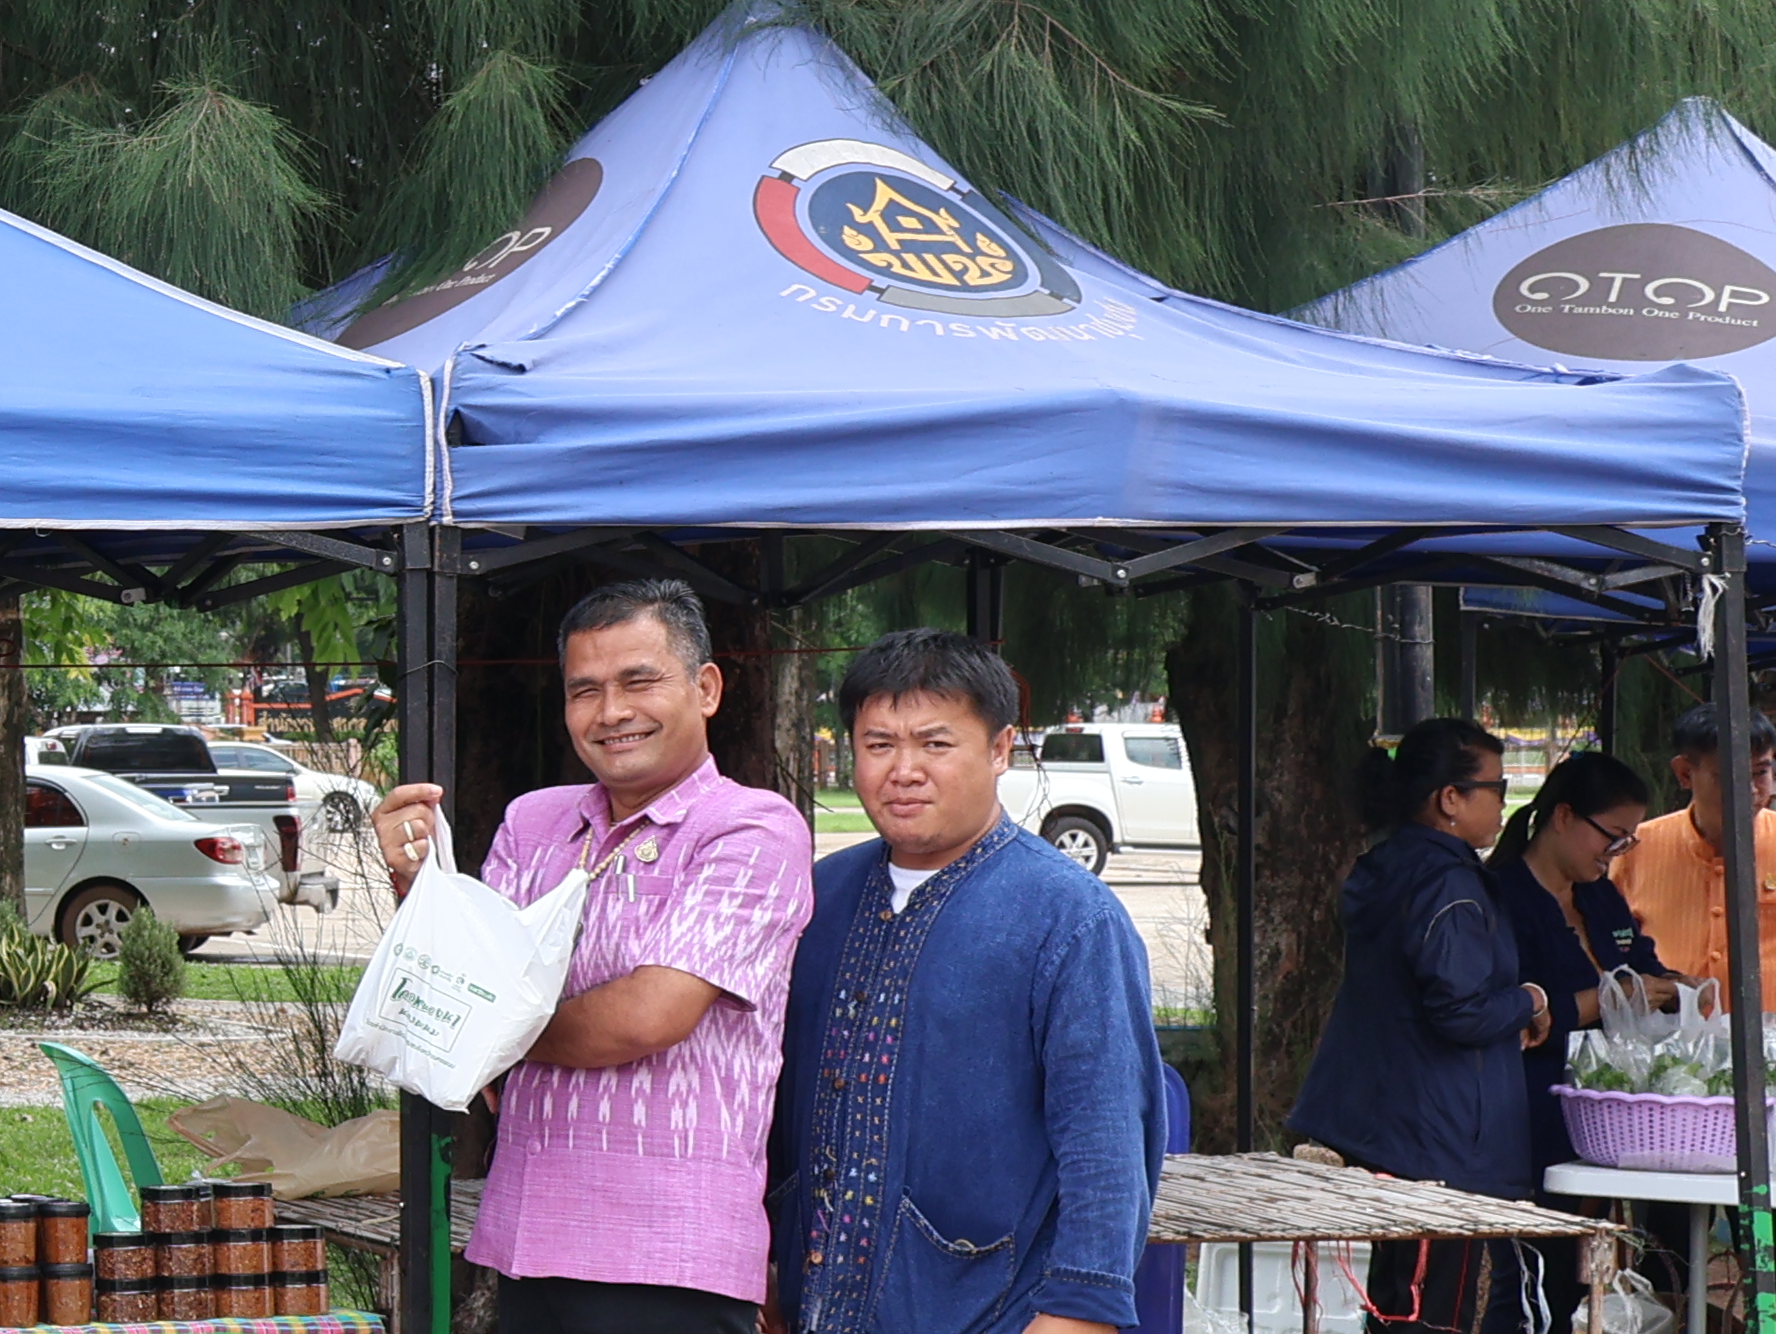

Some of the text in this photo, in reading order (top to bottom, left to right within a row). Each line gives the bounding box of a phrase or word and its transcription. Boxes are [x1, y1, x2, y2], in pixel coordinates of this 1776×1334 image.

[1518, 271, 1770, 313] OTOP
[1515, 302, 1759, 328] One Tambon One Product
